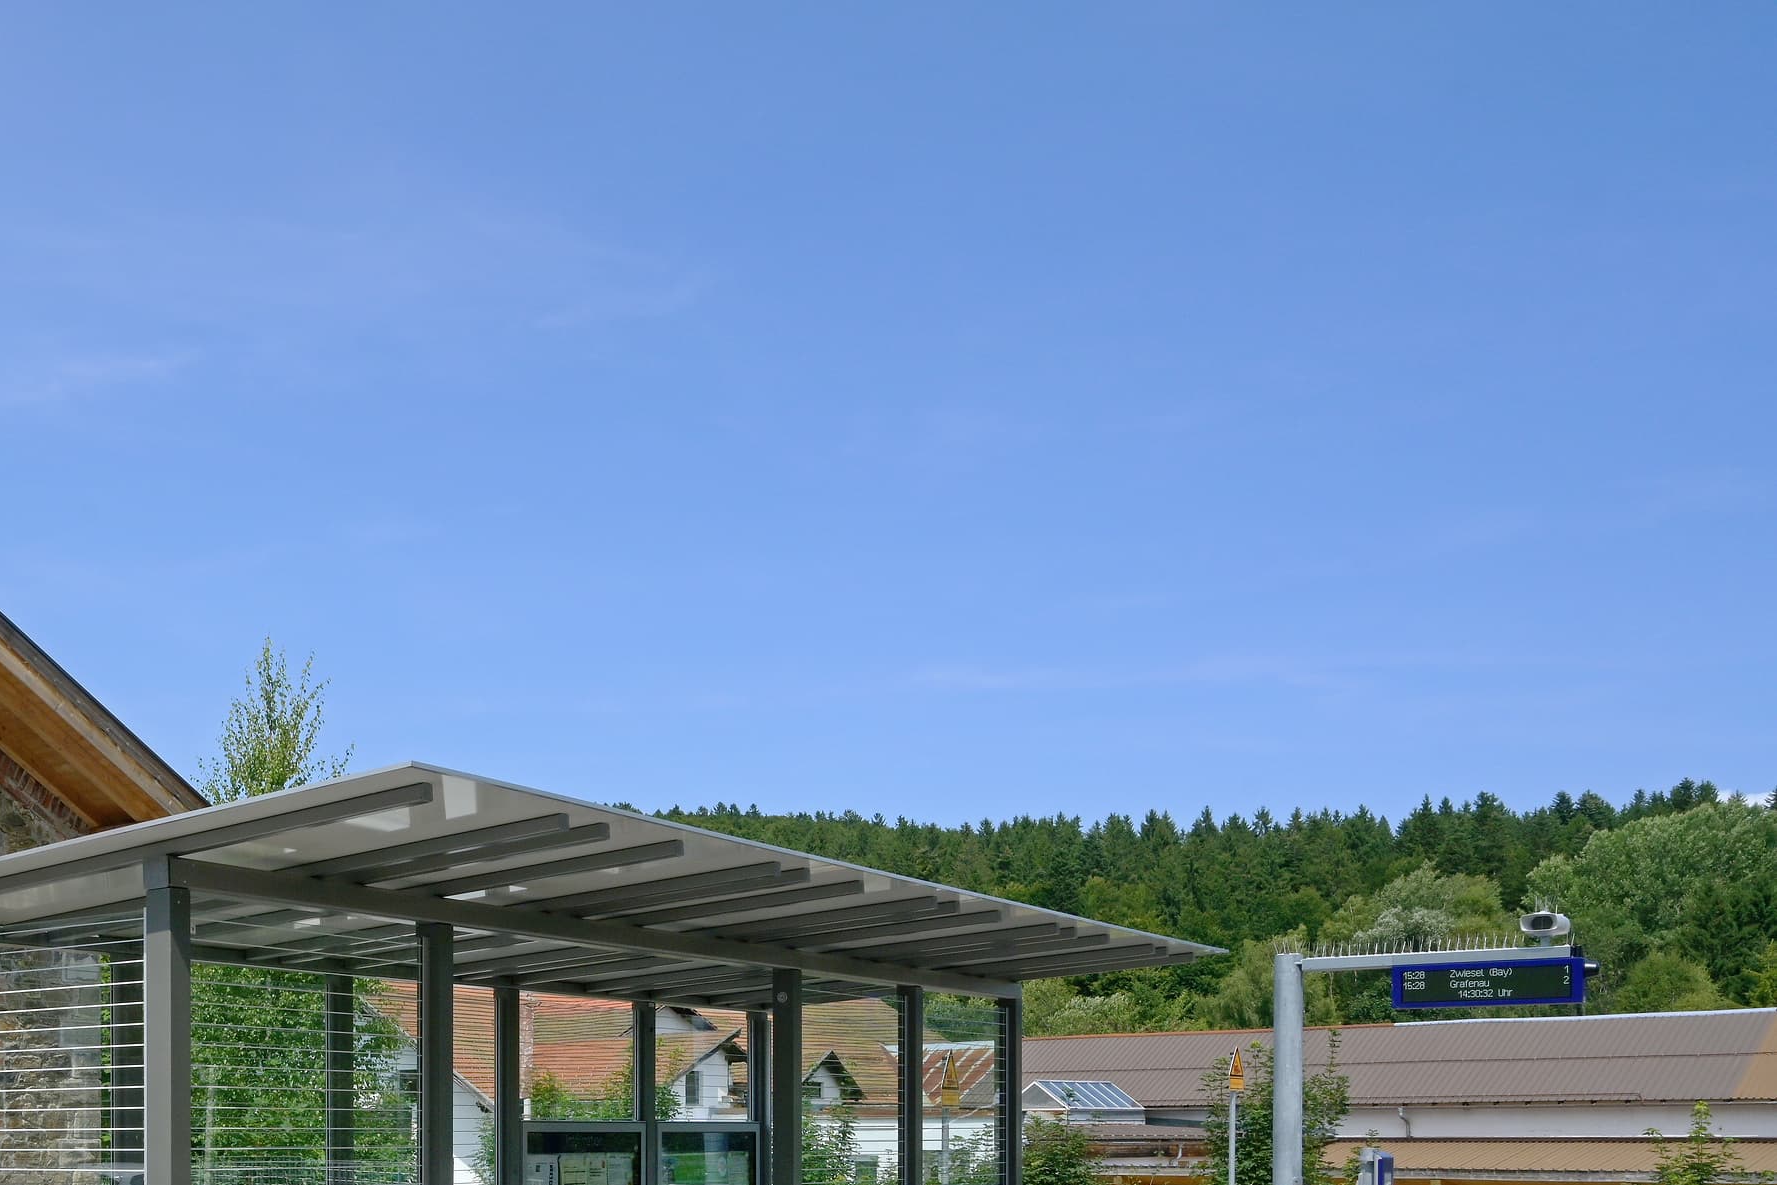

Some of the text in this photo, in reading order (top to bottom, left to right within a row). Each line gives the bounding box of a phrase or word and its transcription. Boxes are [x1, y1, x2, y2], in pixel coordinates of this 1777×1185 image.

[1403, 965, 1570, 980] 15:28 Zwiesel (Bay) 1
[1403, 975, 1570, 990] 15:28 Grafenau 2
[1458, 988, 1513, 998] 14:30:32 Uhr
